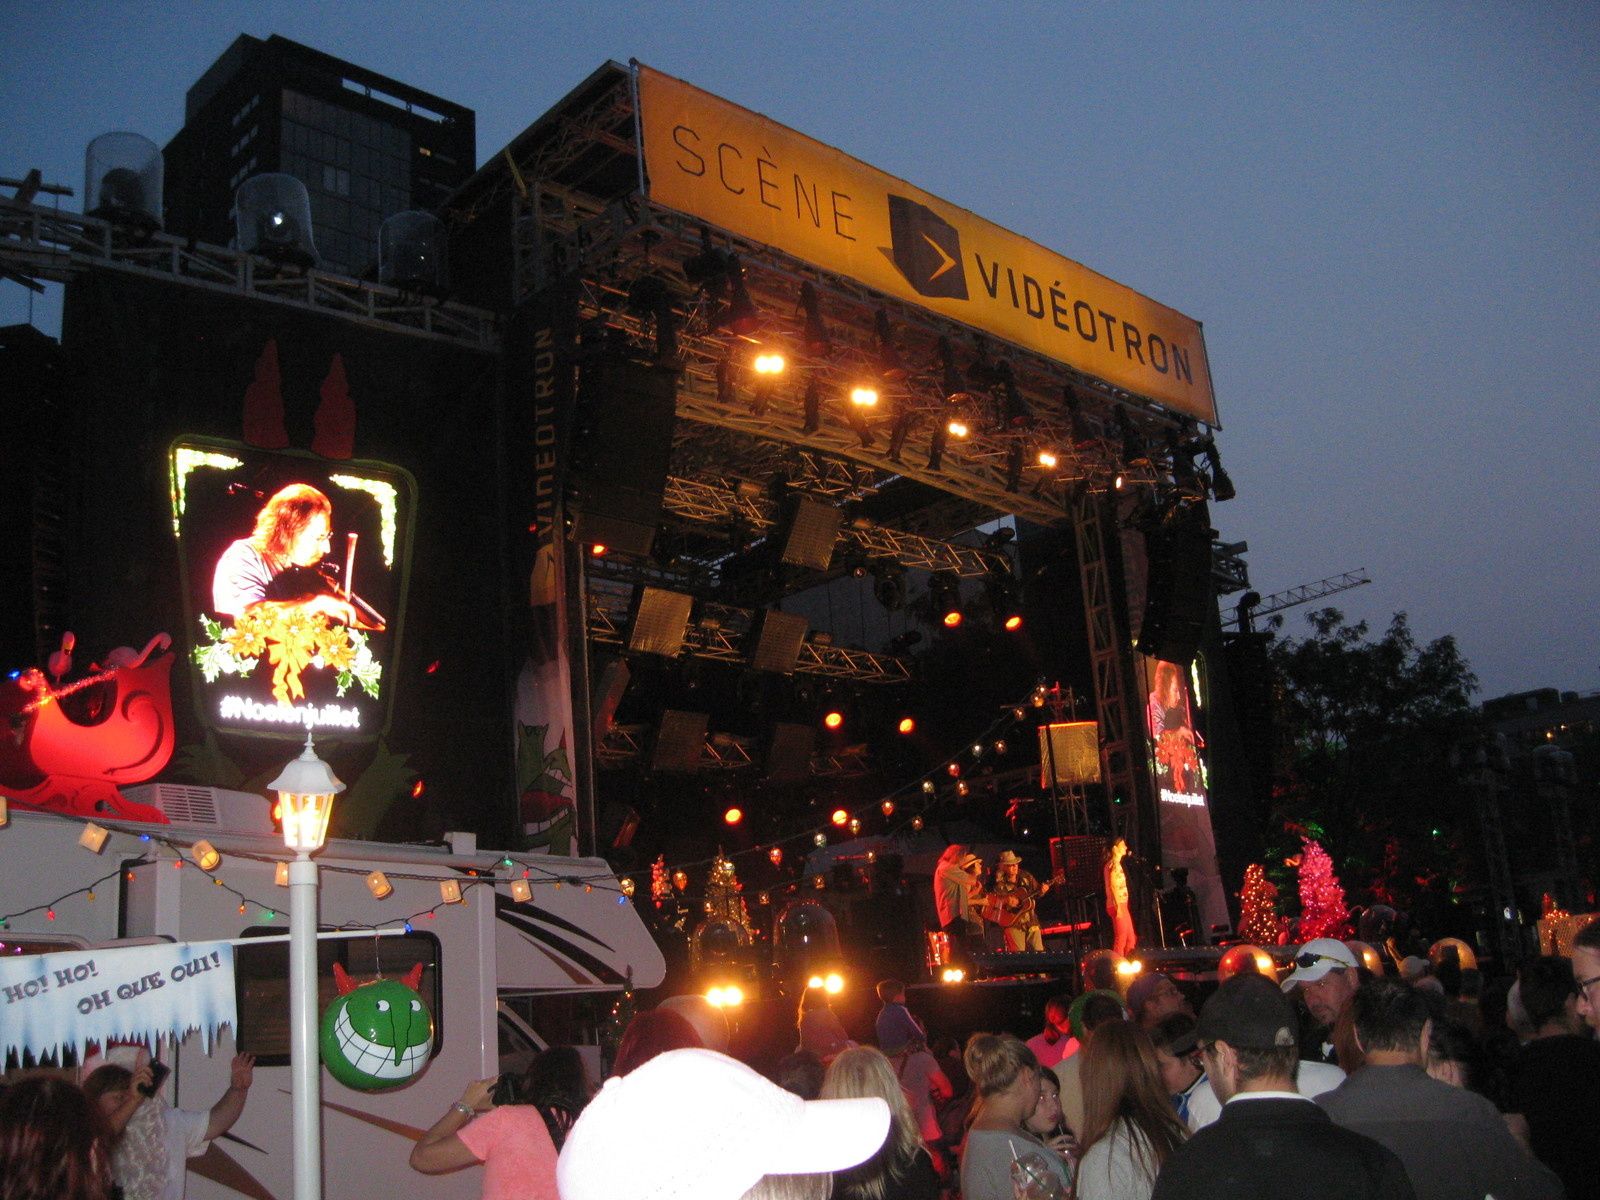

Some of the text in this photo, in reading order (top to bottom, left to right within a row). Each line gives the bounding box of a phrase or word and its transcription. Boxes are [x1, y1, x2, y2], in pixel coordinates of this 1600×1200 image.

[672, 124, 1194, 386] SCÈNE VIDÉOTRON
[2, 959, 99, 1004] HO! HO!
[76, 989, 114, 1015] OH
[116, 971, 167, 1000] QUE
